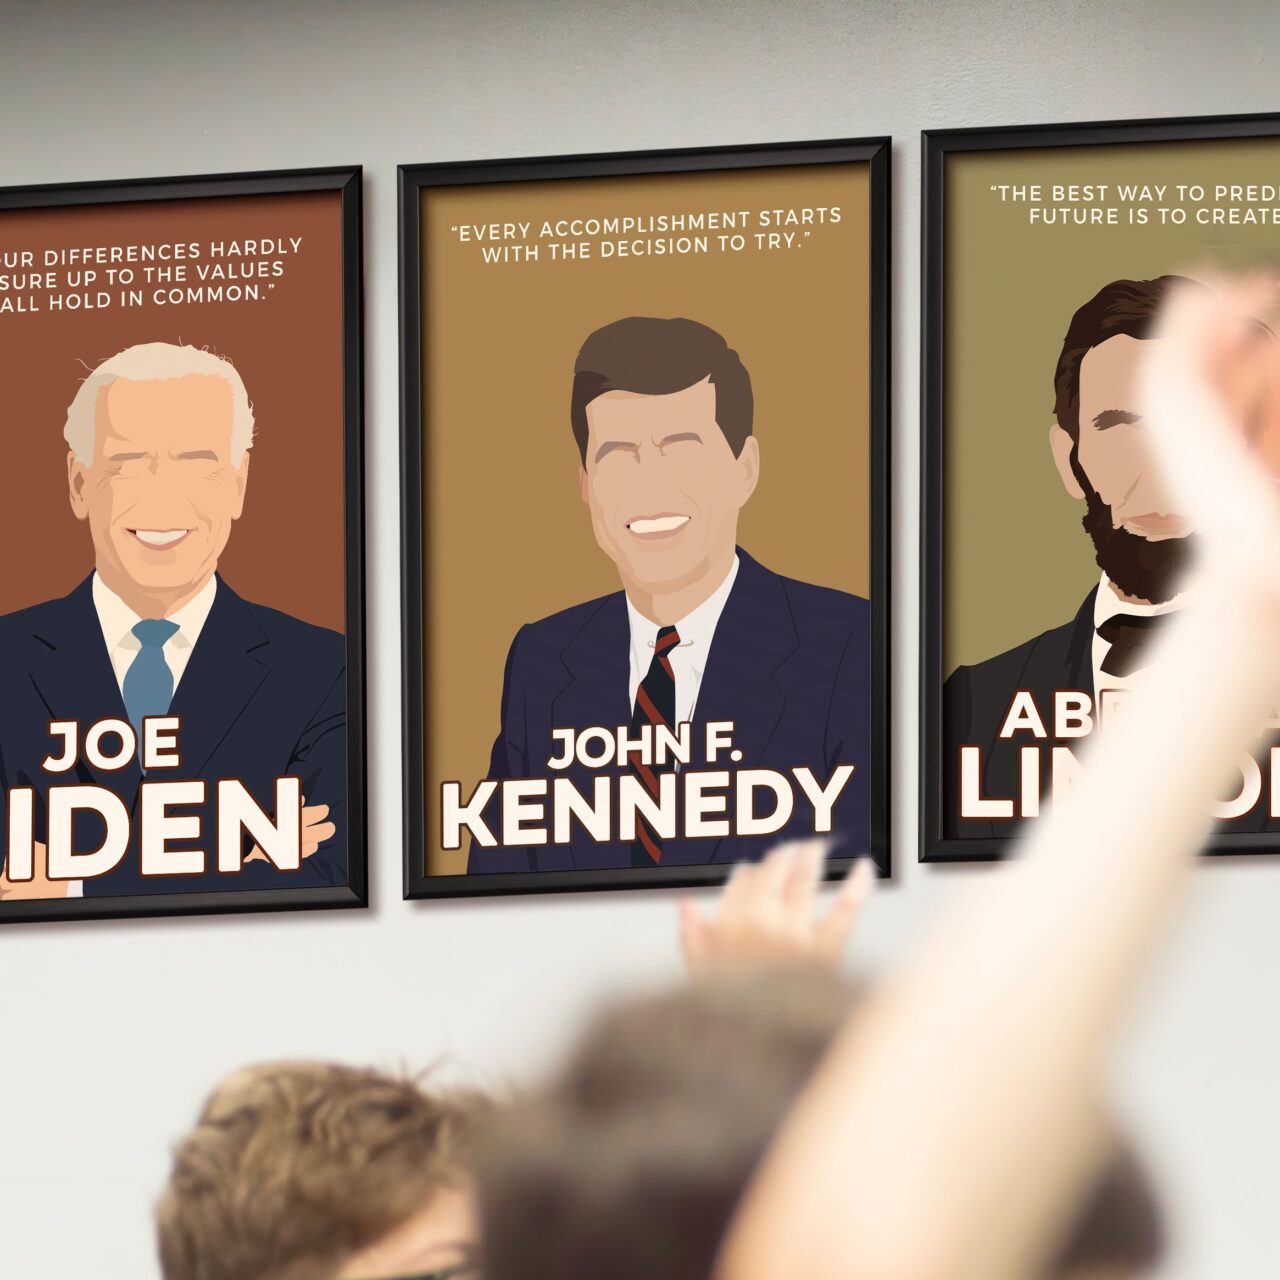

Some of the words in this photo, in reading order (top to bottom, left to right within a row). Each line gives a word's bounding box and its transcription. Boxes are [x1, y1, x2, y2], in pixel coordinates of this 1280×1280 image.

[990, 185, 1042, 202] “THE
[1052, 185, 1108, 202] BEST
[1117, 185, 1167, 201] WAY
[1176, 185, 1205, 202] TO
[451, 222, 530, 242] “EVERY
[539, 211, 750, 237] ACCOMPLISHMENT
[759, 207, 841, 227] STARTS
[1030, 208, 1118, 225] FUTURE
[1129, 208, 1148, 224] IS
[1157, 208, 1187, 225] TO
[0, 251, 33, 268] UR
[44, 242, 200, 266] DIFFERENCES
[211, 237, 302, 258] HARDLY
[482, 245, 538, 263] WITH
[548, 242, 590, 260] THE
[601, 236, 708, 258] DECISION
[717, 235, 745, 251] TO
[754, 231, 808, 250] TRY.”
[0, 272, 57, 291] SURE
[67, 270, 97, 287] UP
[105, 268, 134, 285] TO
[143, 265, 187, 283] THE
[196, 260, 284, 281] VALUES
[0, 295, 39, 313] ALL
[49, 292, 111, 311] HOLD
[121, 290, 143, 307] IN
[153, 283, 275, 305] COMMON.”
[41, 715, 181, 773] JOE
[546, 721, 691, 771] JOHN
[705, 721, 743, 763] F.
[441, 764, 855, 850] KENNEDY
[7, 775, 302, 882] IDEN
